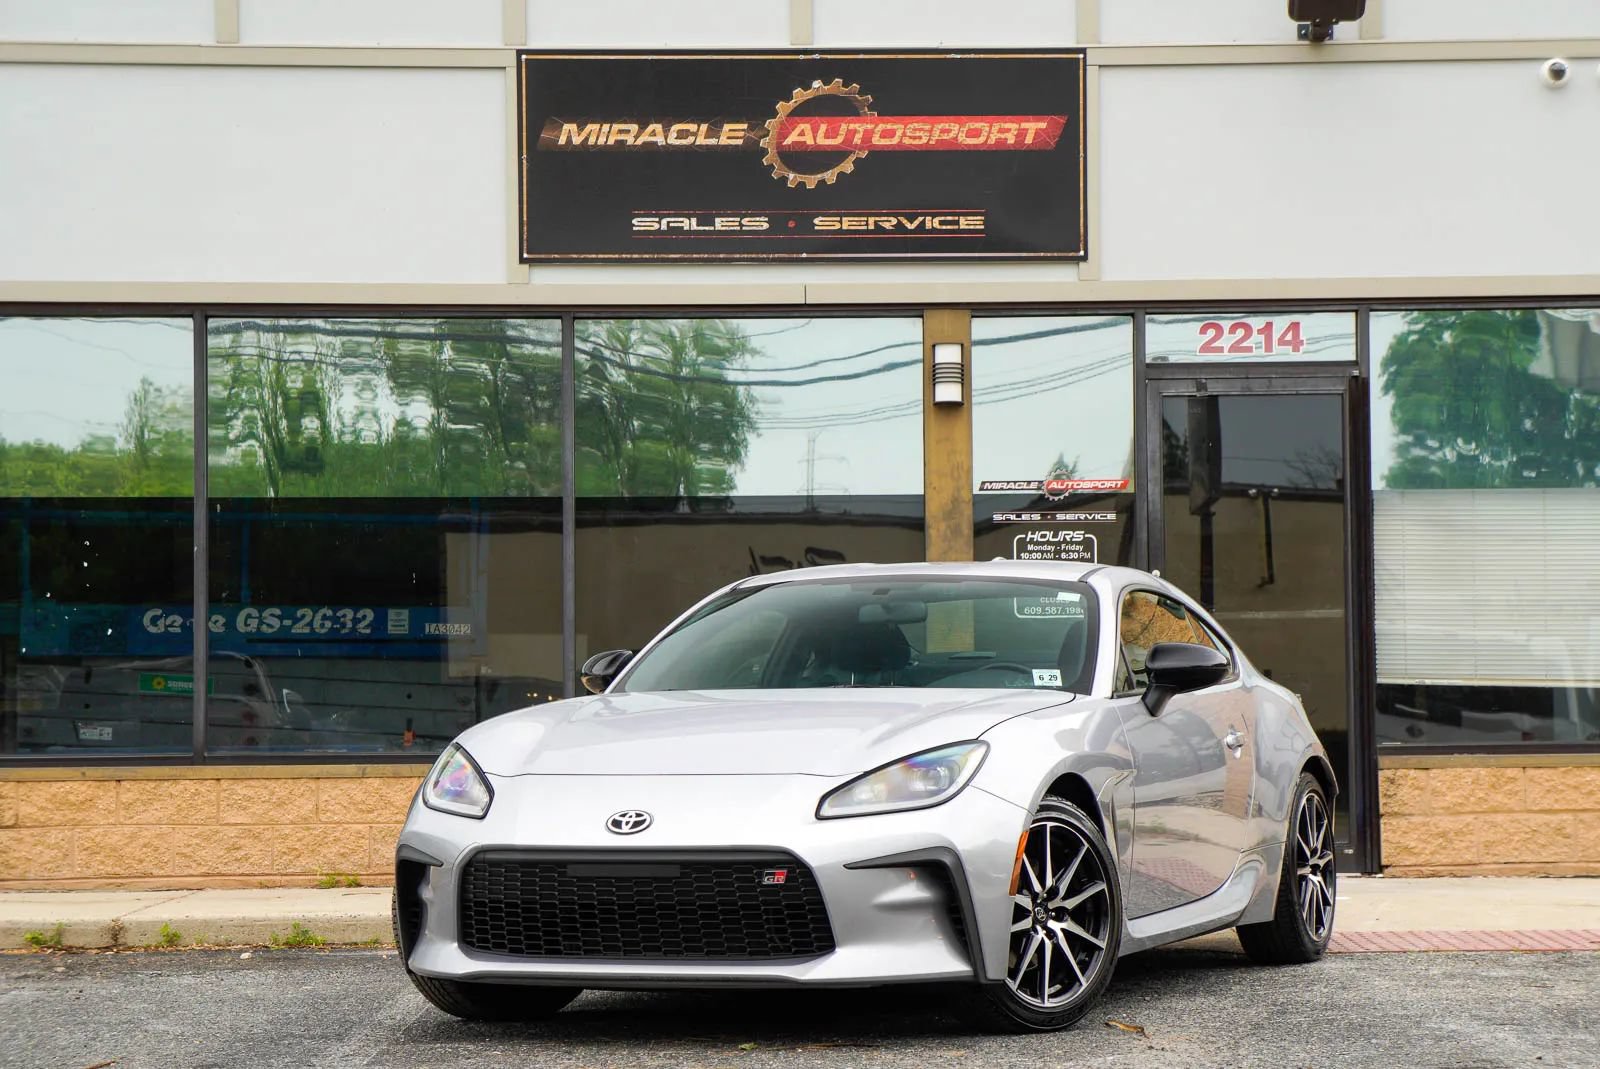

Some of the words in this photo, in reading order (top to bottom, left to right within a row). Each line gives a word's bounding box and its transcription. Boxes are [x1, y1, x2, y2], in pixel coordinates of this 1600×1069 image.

[557, 123, 748, 146] MIRACLE
[782, 122, 1048, 146] AUTOSPORT
[632, 217, 770, 231] SALES
[813, 216, 985, 230] SERVICE
[1198, 321, 1305, 354] 2214
[1048, 481, 1124, 489] AUTOSPORT
[992, 513, 1041, 521] SALES
[1026, 531, 1085, 542] HOURS
[1027, 544, 1055, 552] Monday
[1061, 544, 1084, 552] Friday
[236, 607, 375, 634] GS-2632
[764, 876, 785, 884] GR
